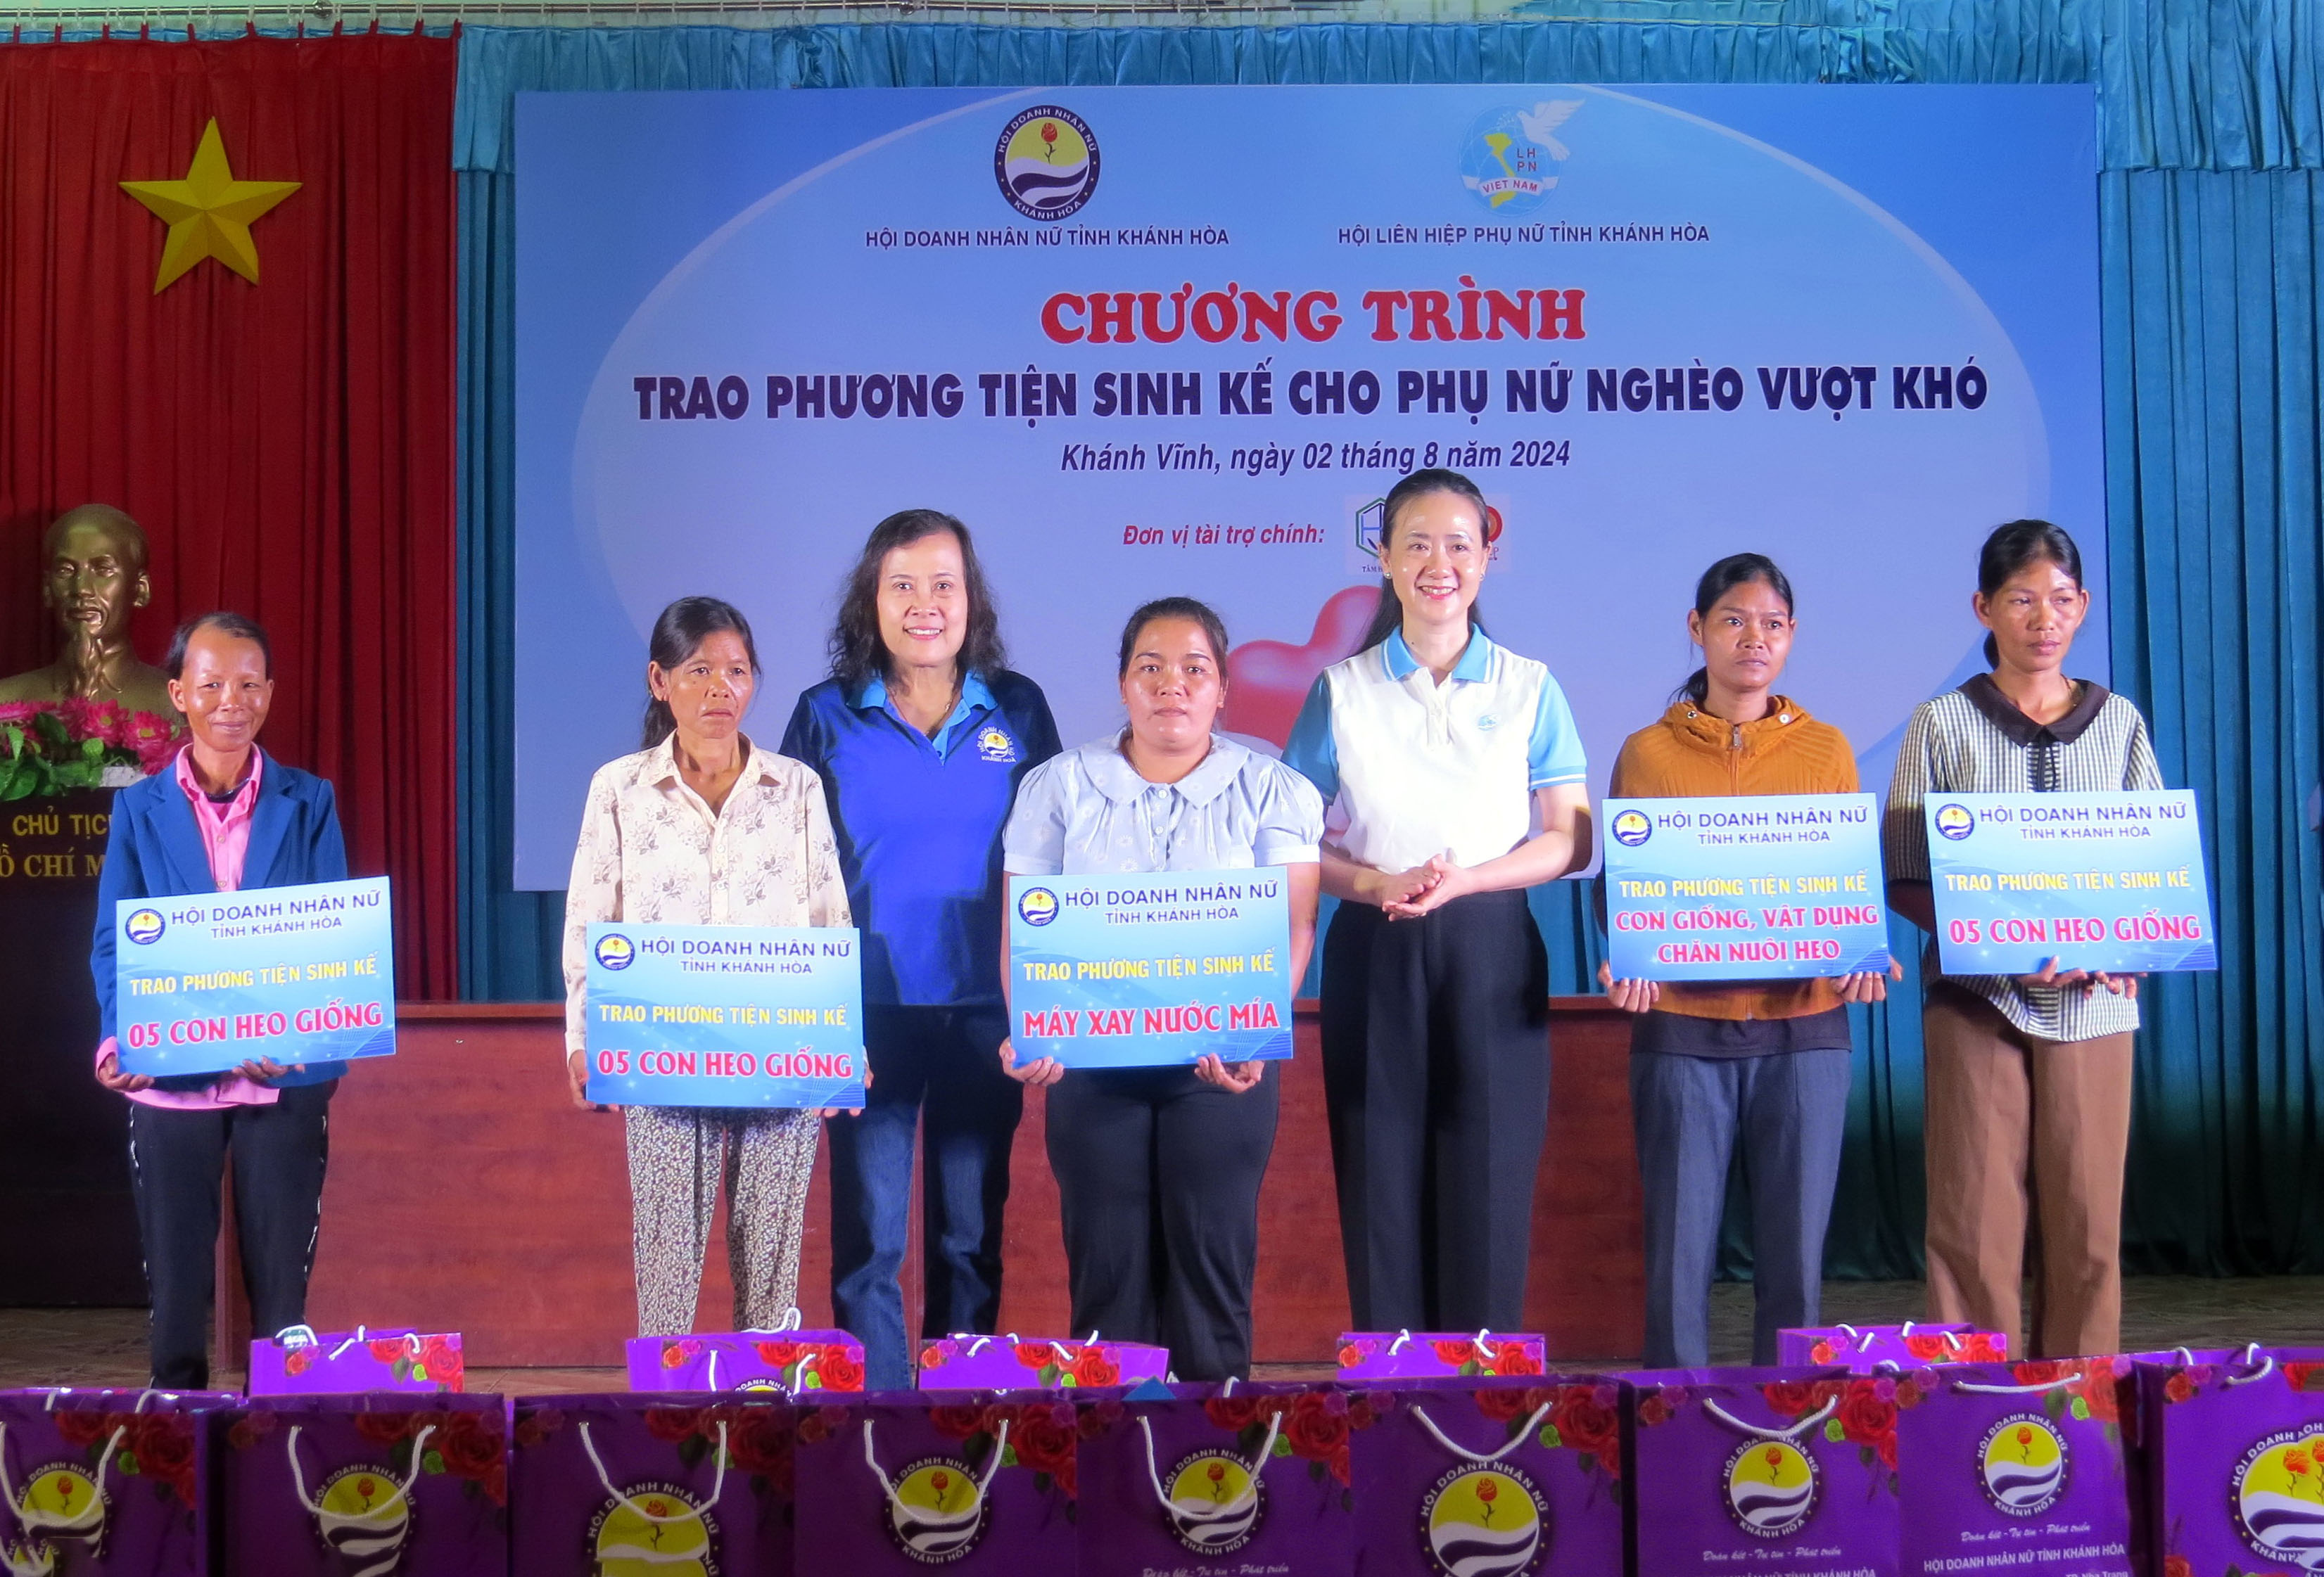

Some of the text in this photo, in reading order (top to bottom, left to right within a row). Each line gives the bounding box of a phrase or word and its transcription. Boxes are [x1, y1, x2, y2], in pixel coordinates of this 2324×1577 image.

[1011, 108, 1050, 129] DOANH
[1513, 180, 1537, 192] NAM
[866, 224, 1229, 250] HỘI DOANH NHÂN NỮ TỈNH KHÁNH HÒA
[1339, 221, 1709, 247] HỘI LIÊN HIỆP PHỤ NỮ TỈNH KHÁNH HÒA
[1041, 275, 1585, 343] CHƯƠNG TRÌNH
[634, 357, 1987, 428] TRAO PHƯƠNG TIỆN SINH KẾ CHO PHỤ NỮ NGHÈO VƯỢT KHÓ
[1062, 440, 1570, 476] Khánh Vĩnh, ngày 02 tháng 8 năm 2024
[1124, 523, 1324, 548] Đơn vị tài trợ chính:
[12, 805, 59, 836] CHỦ
[1658, 810, 1691, 831] HỘI
[1699, 812, 1768, 827] DOANH
[1777, 807, 1831, 824] NHÂN
[1840, 805, 1867, 824] NỮ
[1980, 805, 2012, 825] HỘI
[2021, 807, 2089, 822] DOANH
[2097, 803, 2152, 820] NHÂN
[2159, 802, 2186, 819] NỮ
[1698, 829, 1829, 844] TỈNH KHÁNH HÒA
[2021, 825, 2151, 838] TỈNH KHÁNH HÒA
[24, 847, 75, 877] CHÍ
[1620, 869, 1868, 898] TRAO PHƯƠNG TIỆN SINH KẾ
[1945, 864, 2190, 892] TRAO PHƯƠNG TIỆN SINH KẾ
[1066, 888, 1098, 909] HỘI
[1107, 889, 1178, 905] DOANH
[1186, 882, 1241, 902] NHÂN
[1250, 880, 1278, 898] NỮ
[172, 890, 381, 926] HỘI DOANH NHÂN NỮ
[1105, 905, 1238, 925] TỈNH KHÁNH HÒA
[1615, 905, 1878, 931] CON GIỐNG, VẬT DỤNG
[211, 917, 342, 938] TỈNH KHÁNH HÒA
[1949, 908, 2200, 944] 05 CON HEO GIỐNG
[642, 937, 674, 957] HỘI
[682, 940, 751, 955] DOANH
[761, 939, 815, 957] NHÂN
[823, 940, 851, 957] NỮ
[1658, 938, 1840, 963] CHĂN NUÔI HEO
[131, 952, 379, 995] TRAO PHƯƠNG TIỆN SINH KẾ
[681, 959, 812, 974] TỈNH KHÁNH HÒA
[1024, 947, 1276, 981] TRAO PHƯƠNG TIỆN SINH KẾ
[129, 998, 382, 1048] 05 CON HEO GIỐNG
[599, 1002, 848, 1028] TRAO PHƯƠNG TIỆN SINH KẾ
[1023, 997, 1279, 1038] MÁY XAY NƯỚC MÍA
[598, 1046, 851, 1078] 05 CON HEO GIỐNG
[1988, 1413, 2025, 1436] DOANH
[1437, 1461, 1487, 1487] DOANH
[1946, 1557, 1984, 1570] DOANH
[1986, 1552, 2016, 1566] NHÂN
